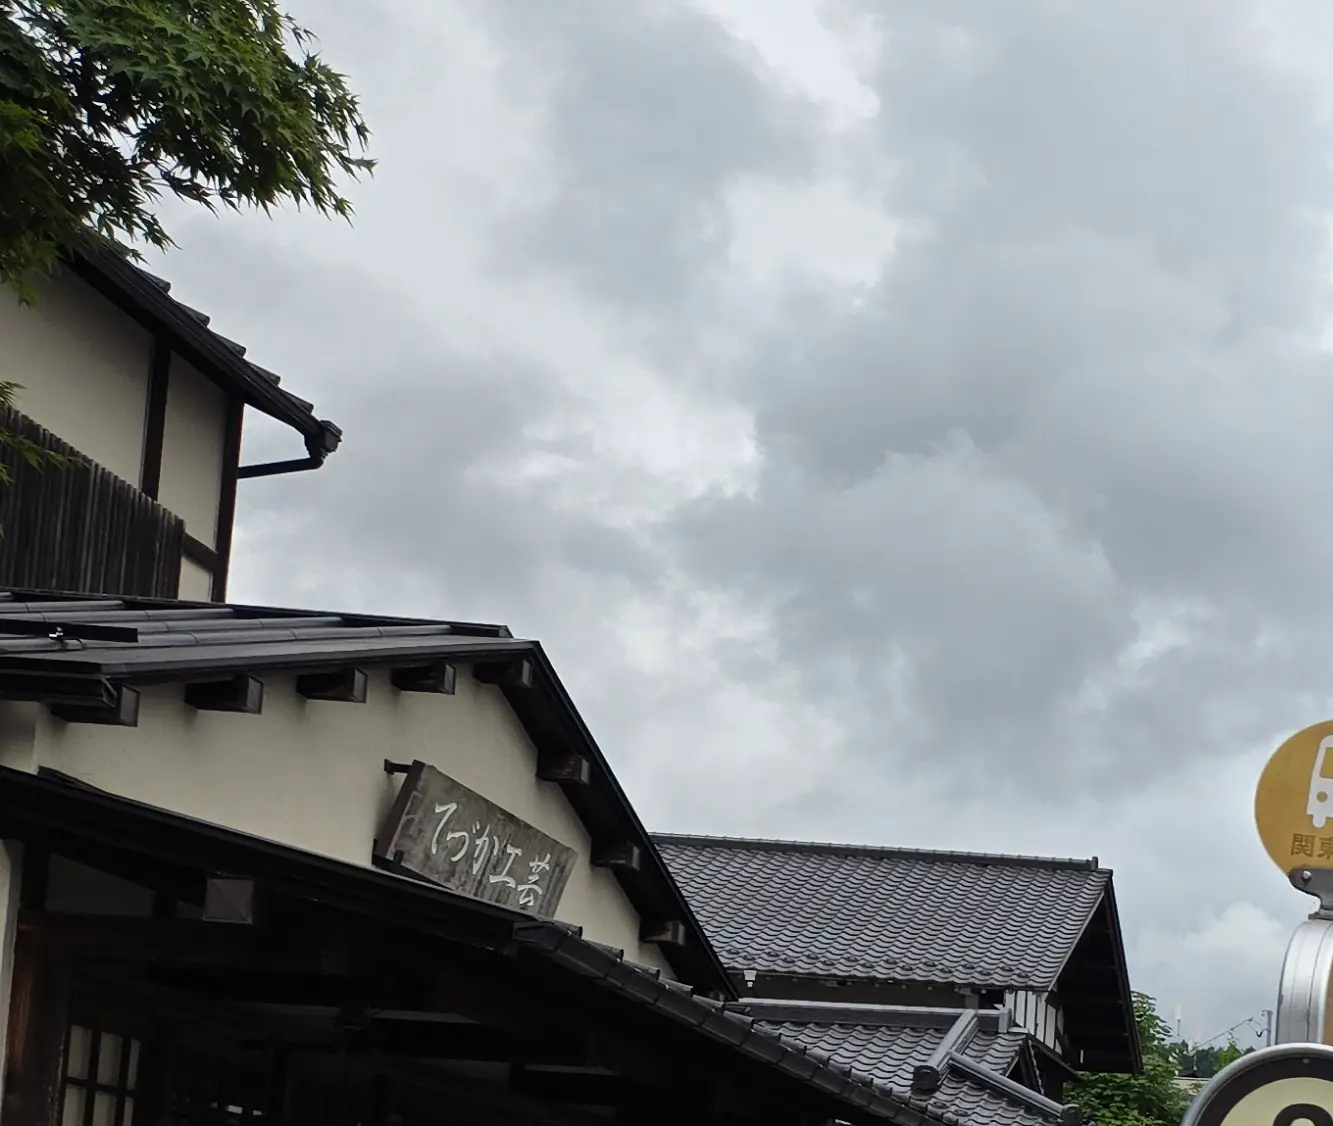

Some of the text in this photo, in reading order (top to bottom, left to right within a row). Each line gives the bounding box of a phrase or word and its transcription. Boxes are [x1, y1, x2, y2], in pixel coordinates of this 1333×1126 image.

[431, 802, 551, 907] てづか工芸
